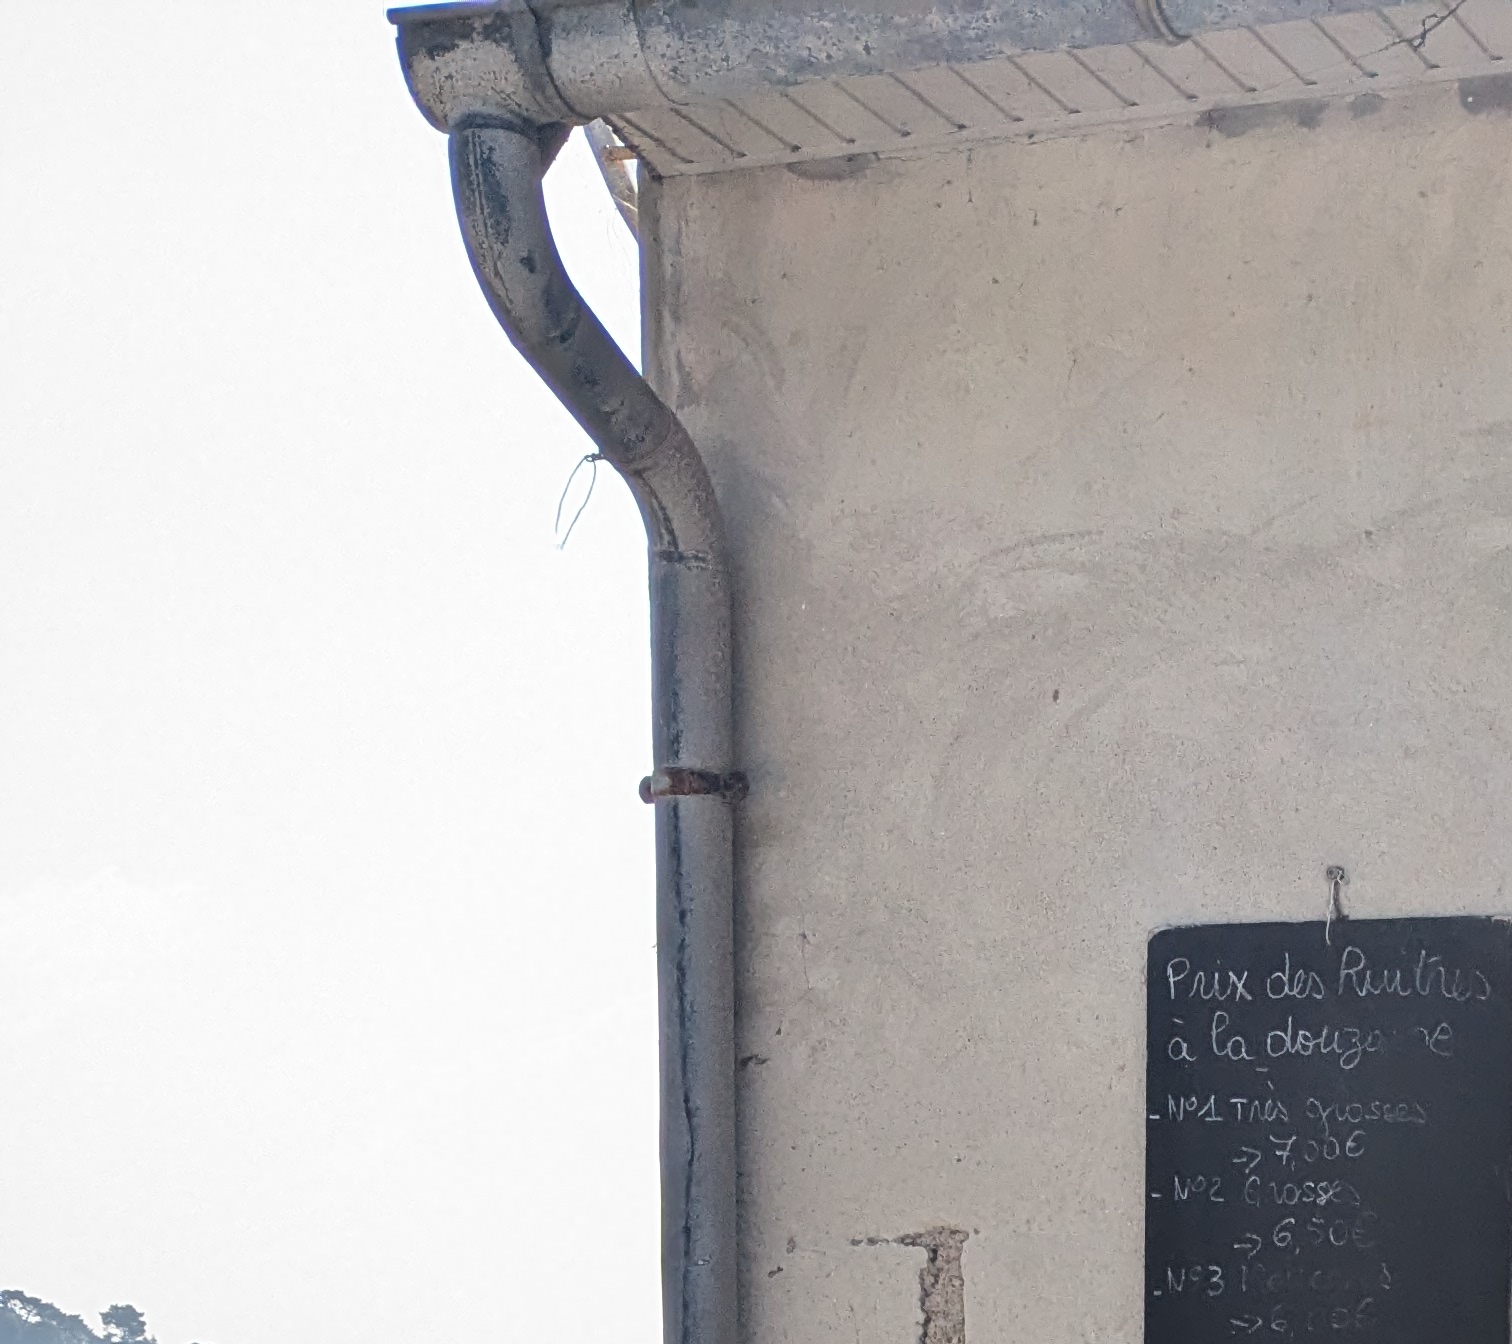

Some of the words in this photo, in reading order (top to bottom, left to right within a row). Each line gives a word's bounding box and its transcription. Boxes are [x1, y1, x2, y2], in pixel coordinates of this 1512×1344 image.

[1167, 958, 1253, 1001] Prix
[1266, 952, 1325, 1000] des
[1168, 1017, 1197, 1062] à
[1211, 1011, 1255, 1061] la
[1269, 1130, 1366, 1171] 7,00€
